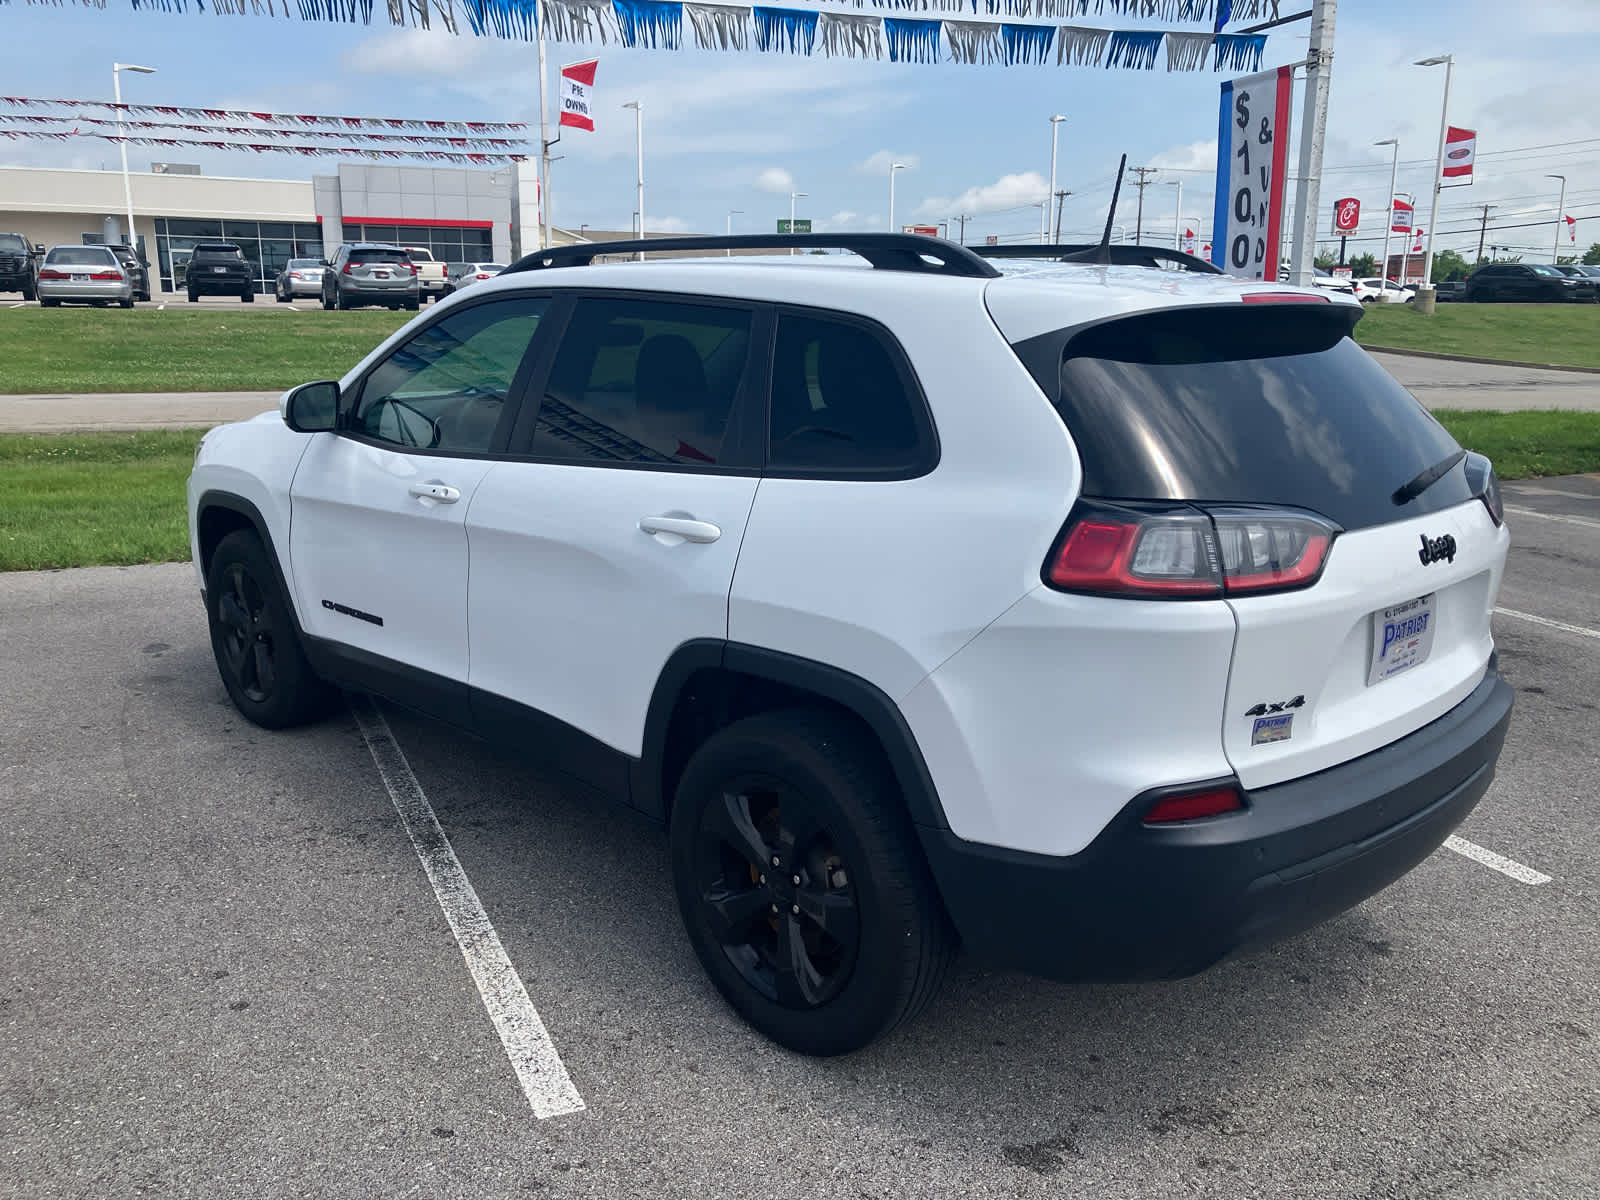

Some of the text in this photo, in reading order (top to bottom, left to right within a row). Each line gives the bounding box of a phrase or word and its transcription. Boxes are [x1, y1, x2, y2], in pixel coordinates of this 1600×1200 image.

[1418, 533, 1457, 567] Jeep
[1382, 613, 1430, 657] PATRIOT
[1244, 694, 1306, 717] 4x4
